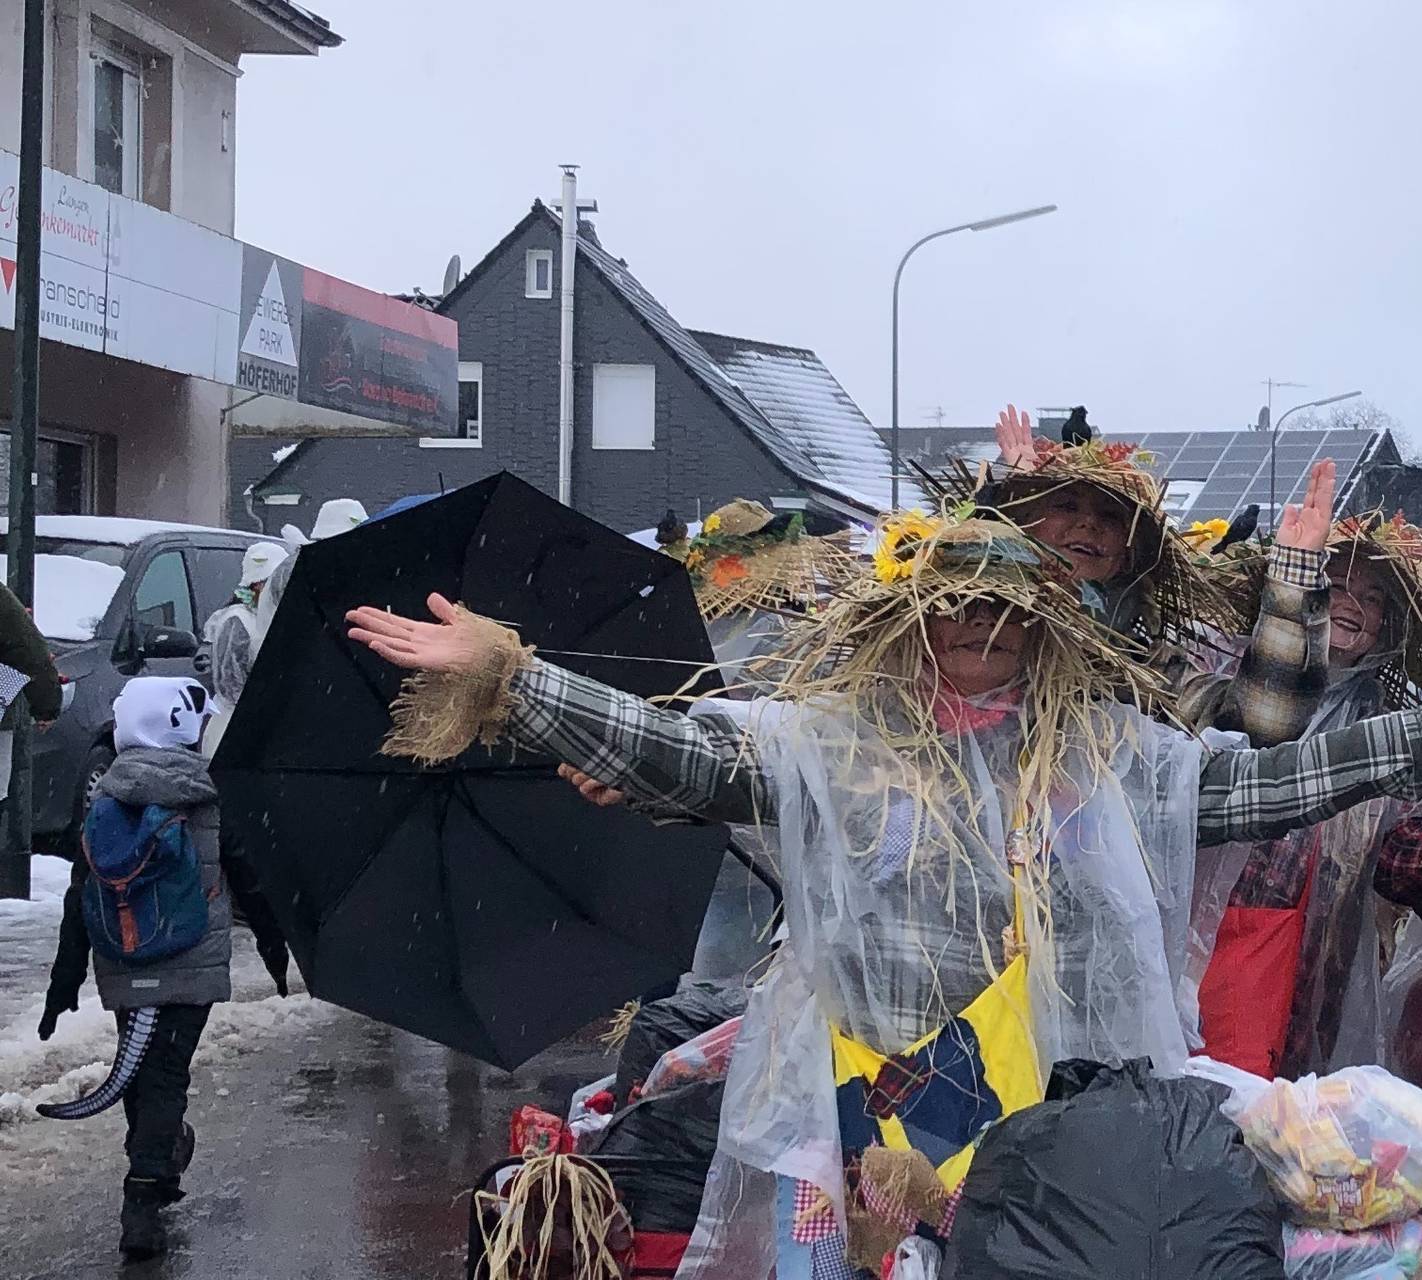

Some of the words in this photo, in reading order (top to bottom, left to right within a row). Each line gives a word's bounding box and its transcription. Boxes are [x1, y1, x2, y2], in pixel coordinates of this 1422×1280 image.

[0, 185, 99, 247] Gnkemarkt
[40, 277, 120, 320] ranscheid
[259, 327, 283, 356] PARK
[238, 360, 298, 396] HOFERHOF
